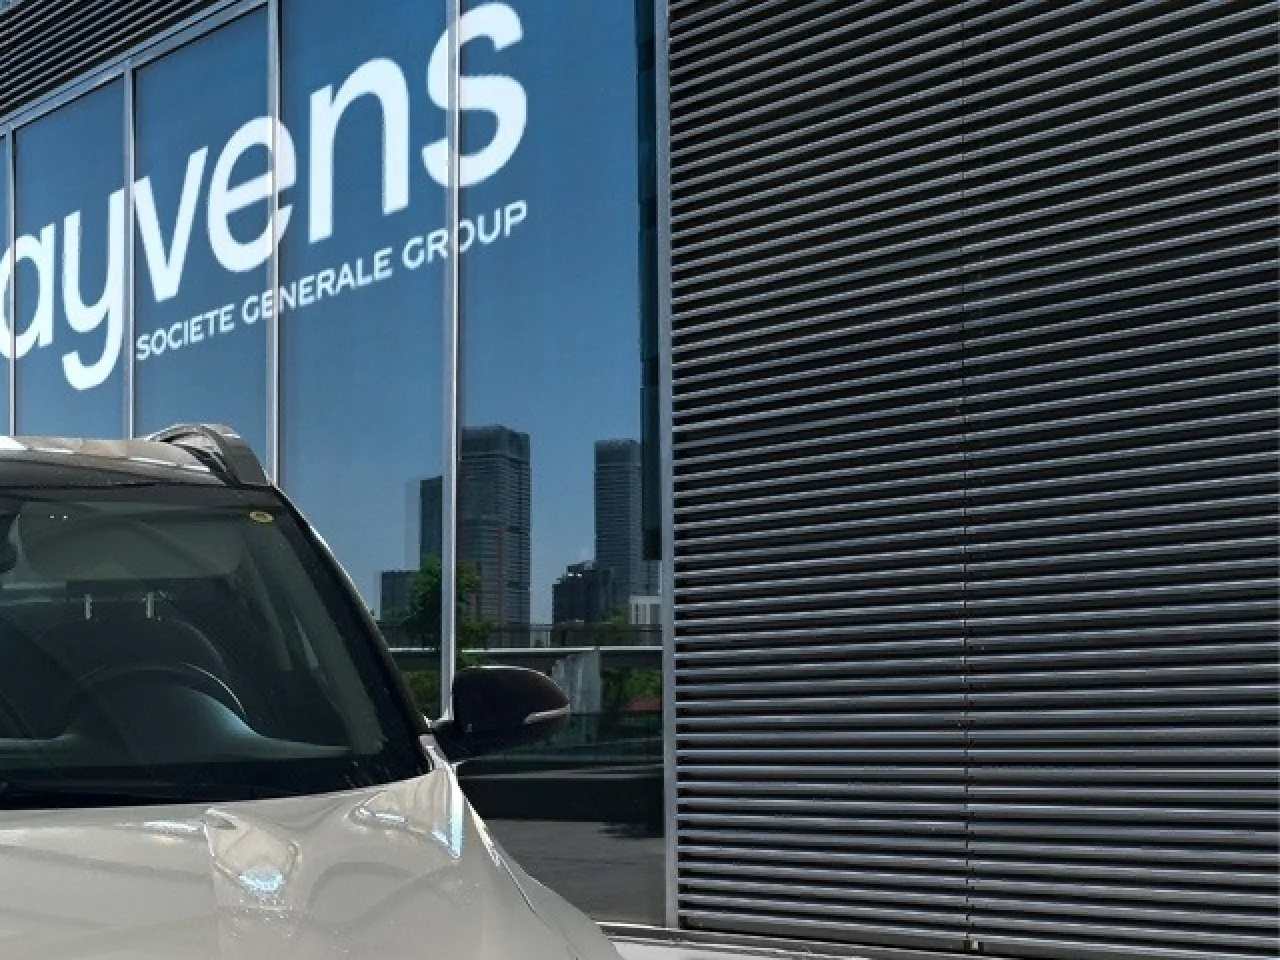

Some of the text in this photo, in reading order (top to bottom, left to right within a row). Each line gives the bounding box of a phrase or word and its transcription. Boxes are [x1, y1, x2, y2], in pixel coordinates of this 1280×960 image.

[136, 200, 528, 361] SOCIETE GENERALE GROUP
